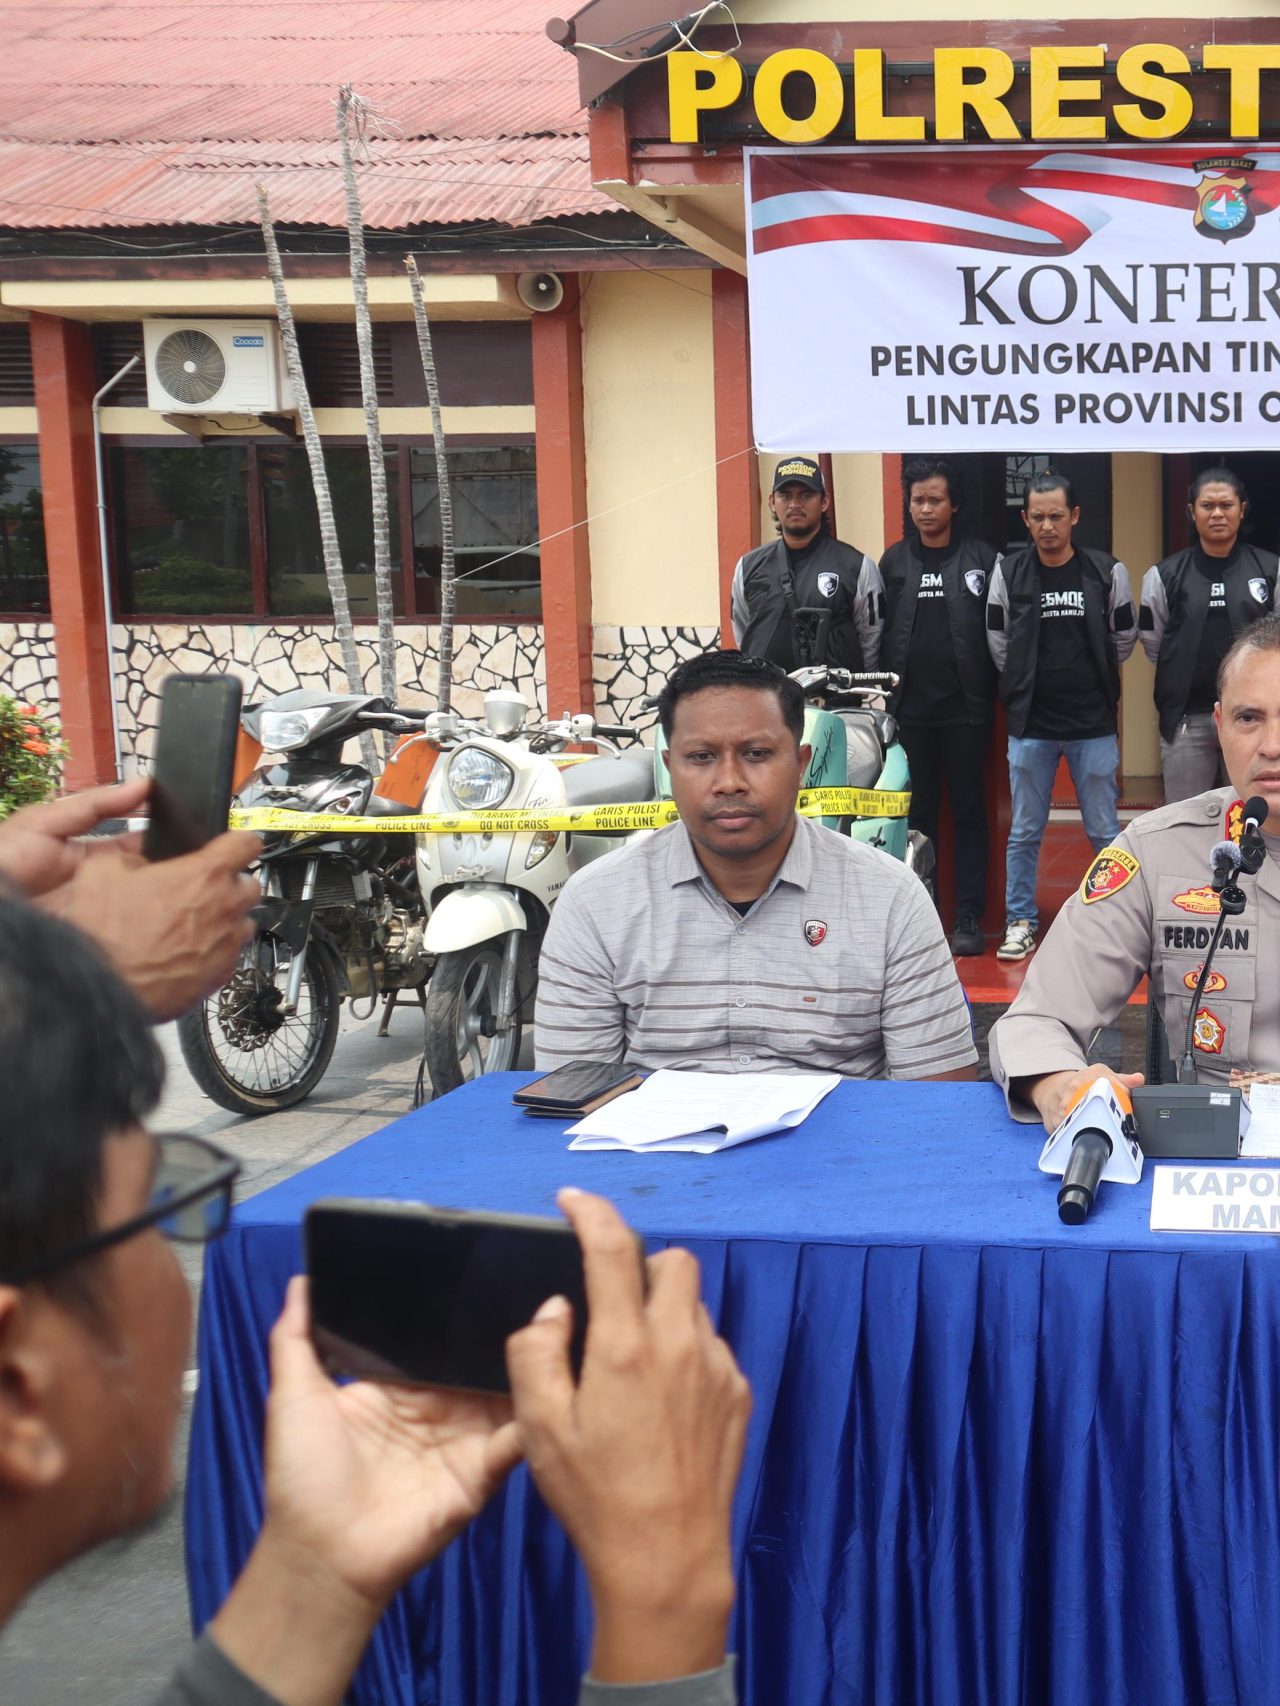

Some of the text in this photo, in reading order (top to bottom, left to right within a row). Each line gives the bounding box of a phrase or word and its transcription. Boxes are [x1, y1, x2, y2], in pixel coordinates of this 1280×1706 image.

[1231, 160, 1253, 169] BARAT
[872, 341, 1211, 376] PENGUNGKAPAN
[907, 392, 1040, 426] LINTAS
[1055, 391, 1242, 424] PROVINSI
[593, 804, 660, 817] GARIS POLISI
[821, 803, 840, 813] POLICE
[410, 822, 432, 831] LINE
[479, 819, 549, 830] DO NOT CROSS
[595, 817, 656, 829] POLICE LINE
